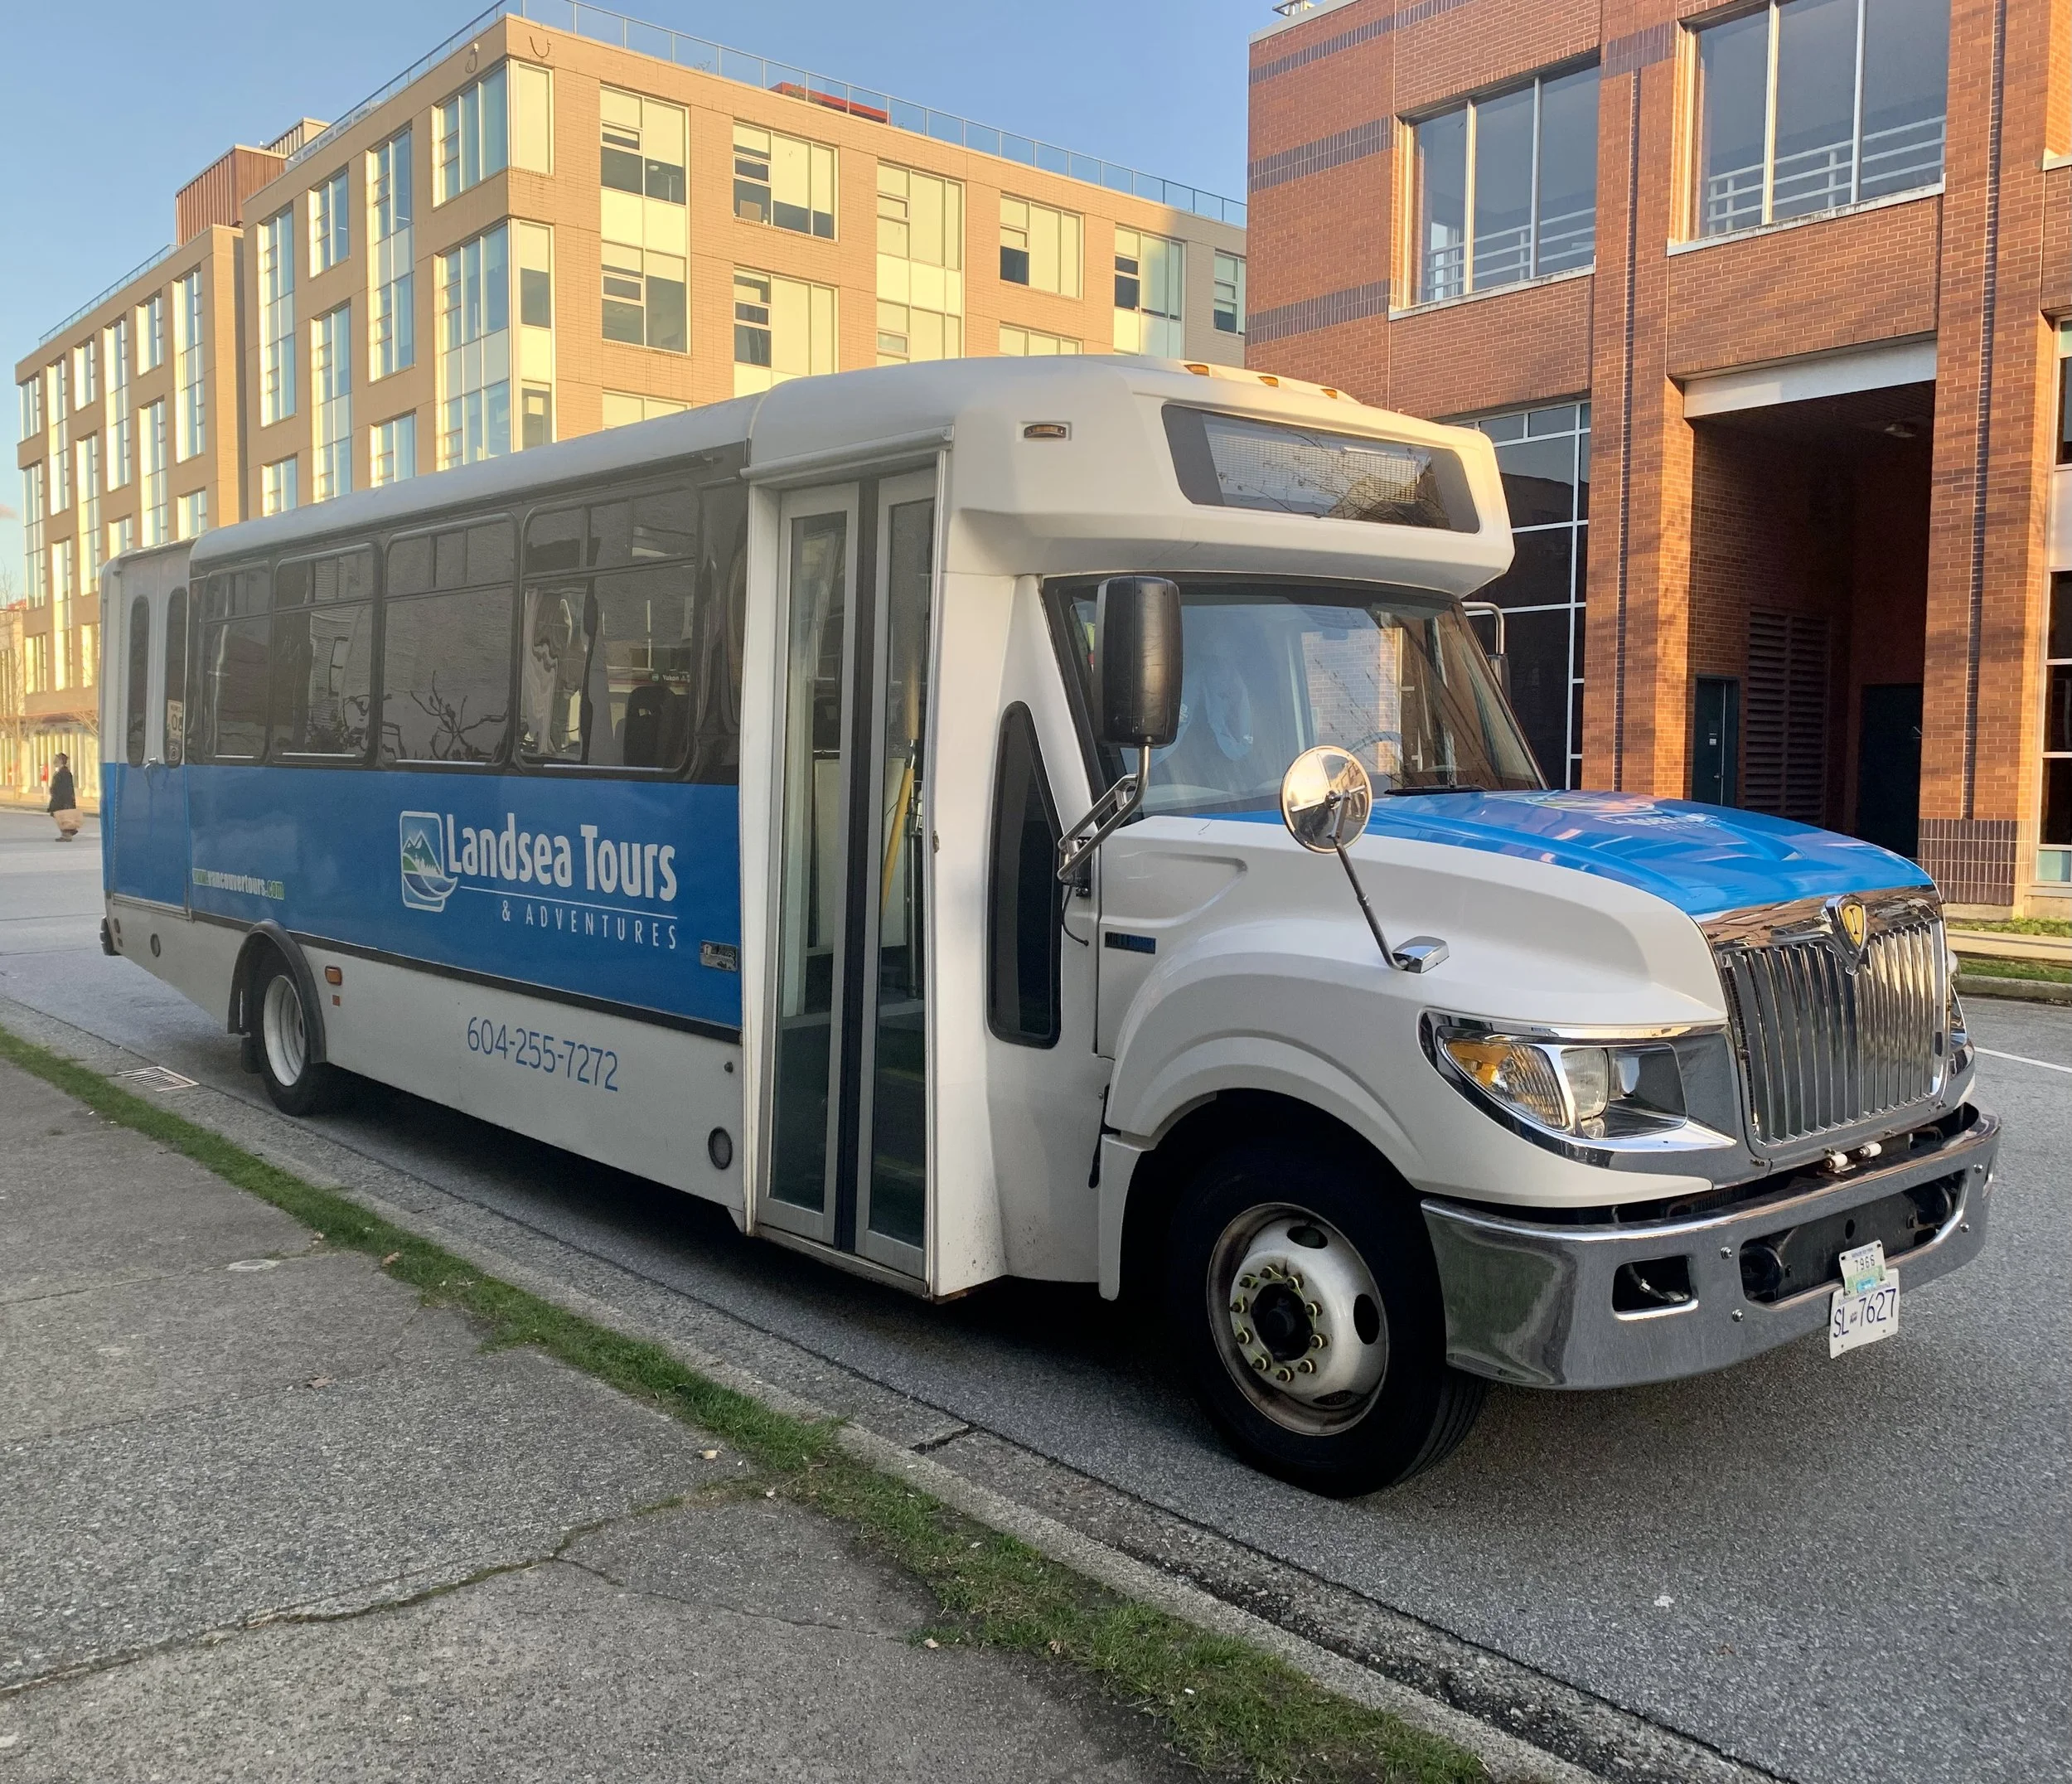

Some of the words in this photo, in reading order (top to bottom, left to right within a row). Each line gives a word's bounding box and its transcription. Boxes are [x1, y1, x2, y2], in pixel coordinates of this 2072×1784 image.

[446, 812, 573, 888] Landsea
[580, 824, 678, 902] Tours
[501, 899, 511, 922] &
[525, 903, 676, 950] ADVENTURES
[467, 1016, 618, 1093] 604-255-7272
[1833, 1306, 1850, 1338] SL
[1858, 1288, 1896, 1327] 7627
